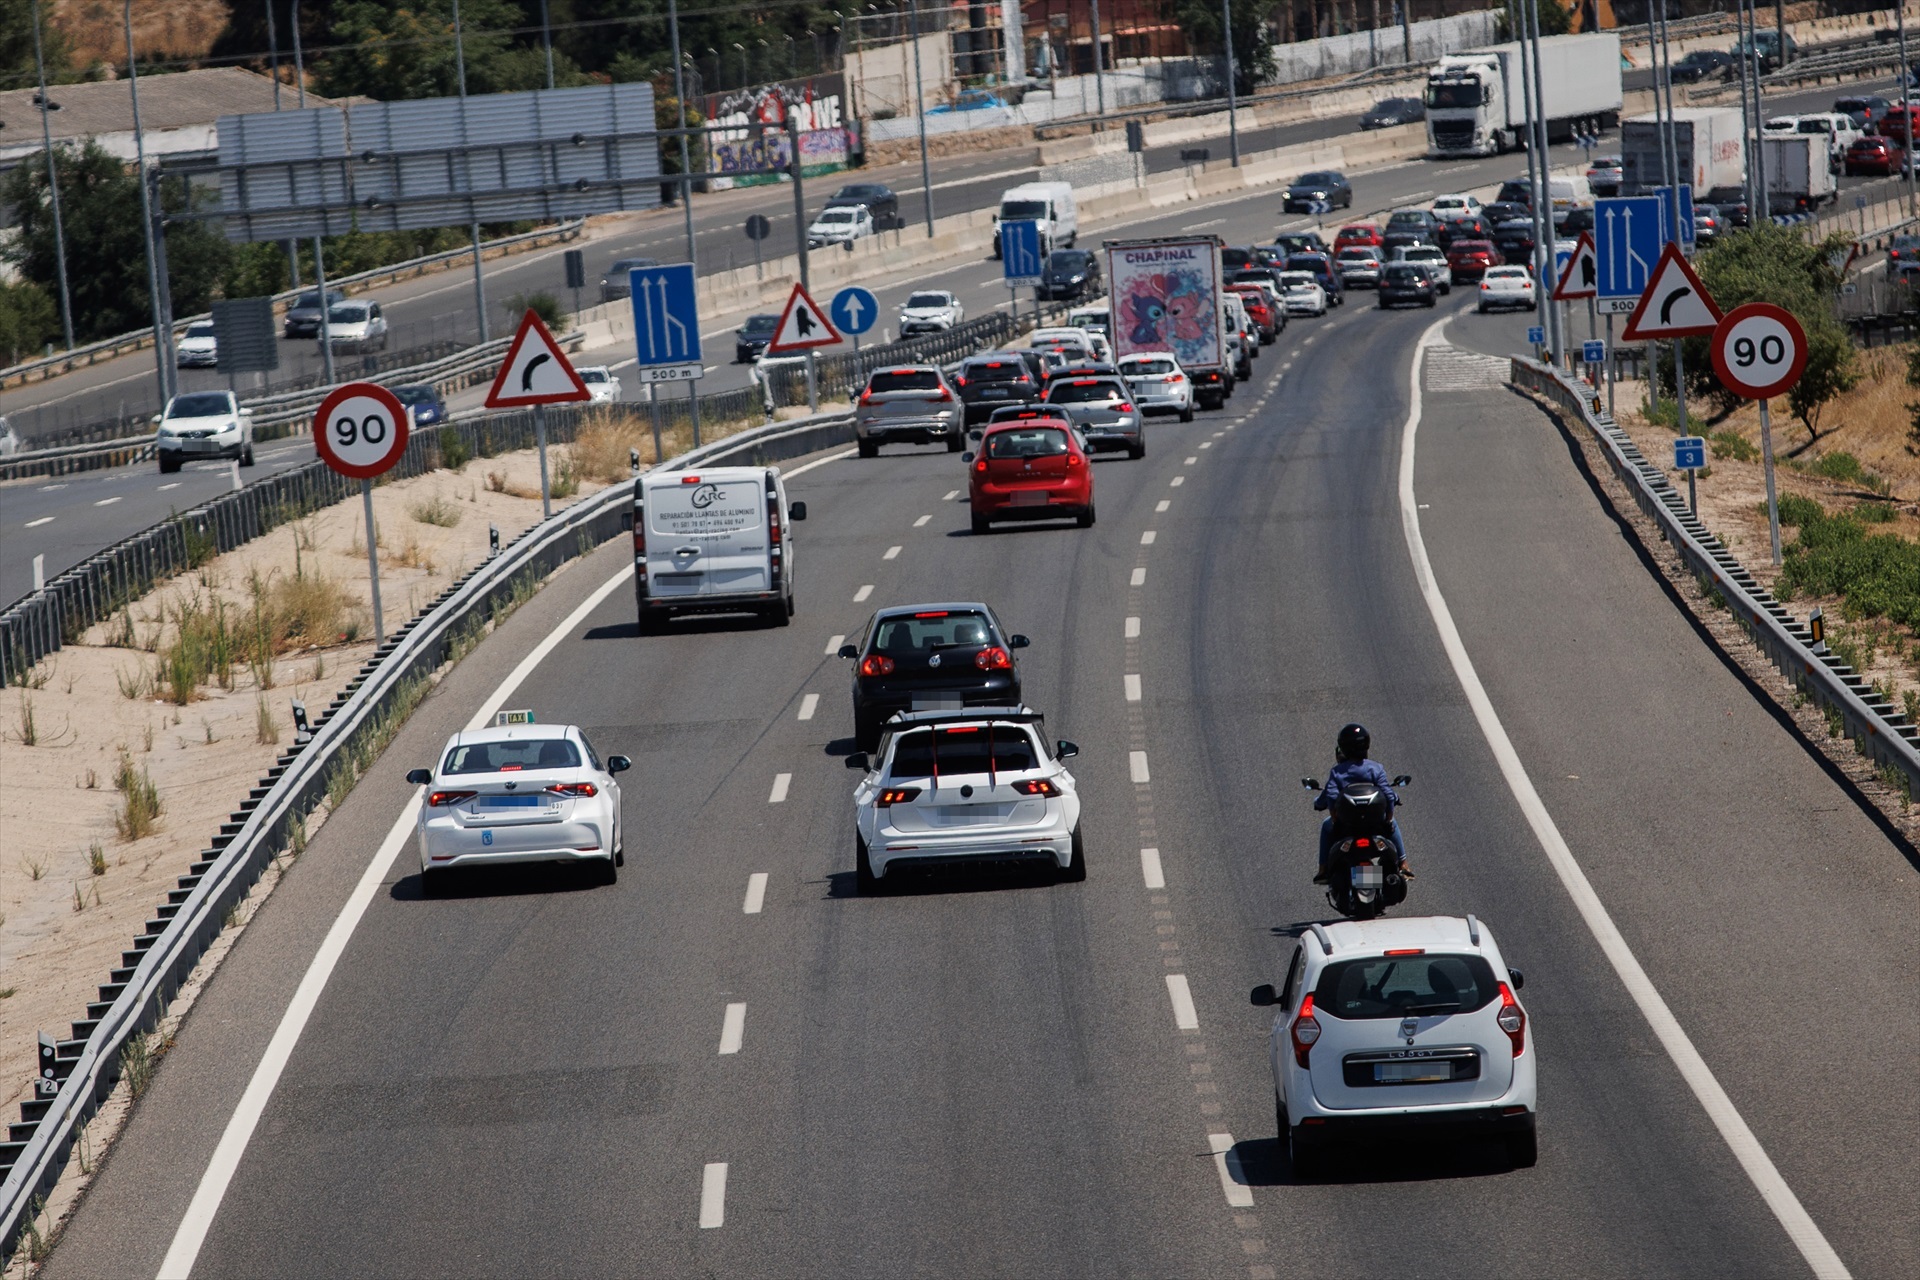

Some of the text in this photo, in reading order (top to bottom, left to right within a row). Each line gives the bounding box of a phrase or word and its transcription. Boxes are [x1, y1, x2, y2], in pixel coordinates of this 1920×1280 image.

[1125, 248, 1197, 263] CHAPINAL
[1611, 301, 1635, 310] 500
[1734, 335, 1785, 367] 90
[652, 369, 692, 379] 500 m
[336, 414, 386, 446] 90
[1685, 452, 1695, 463] 3
[659, 508, 755, 520] REPARACIÓN LLANTAS DE ALUMINIO
[508, 713, 526, 722] TAXI
[45, 1080, 52, 1092] 2
